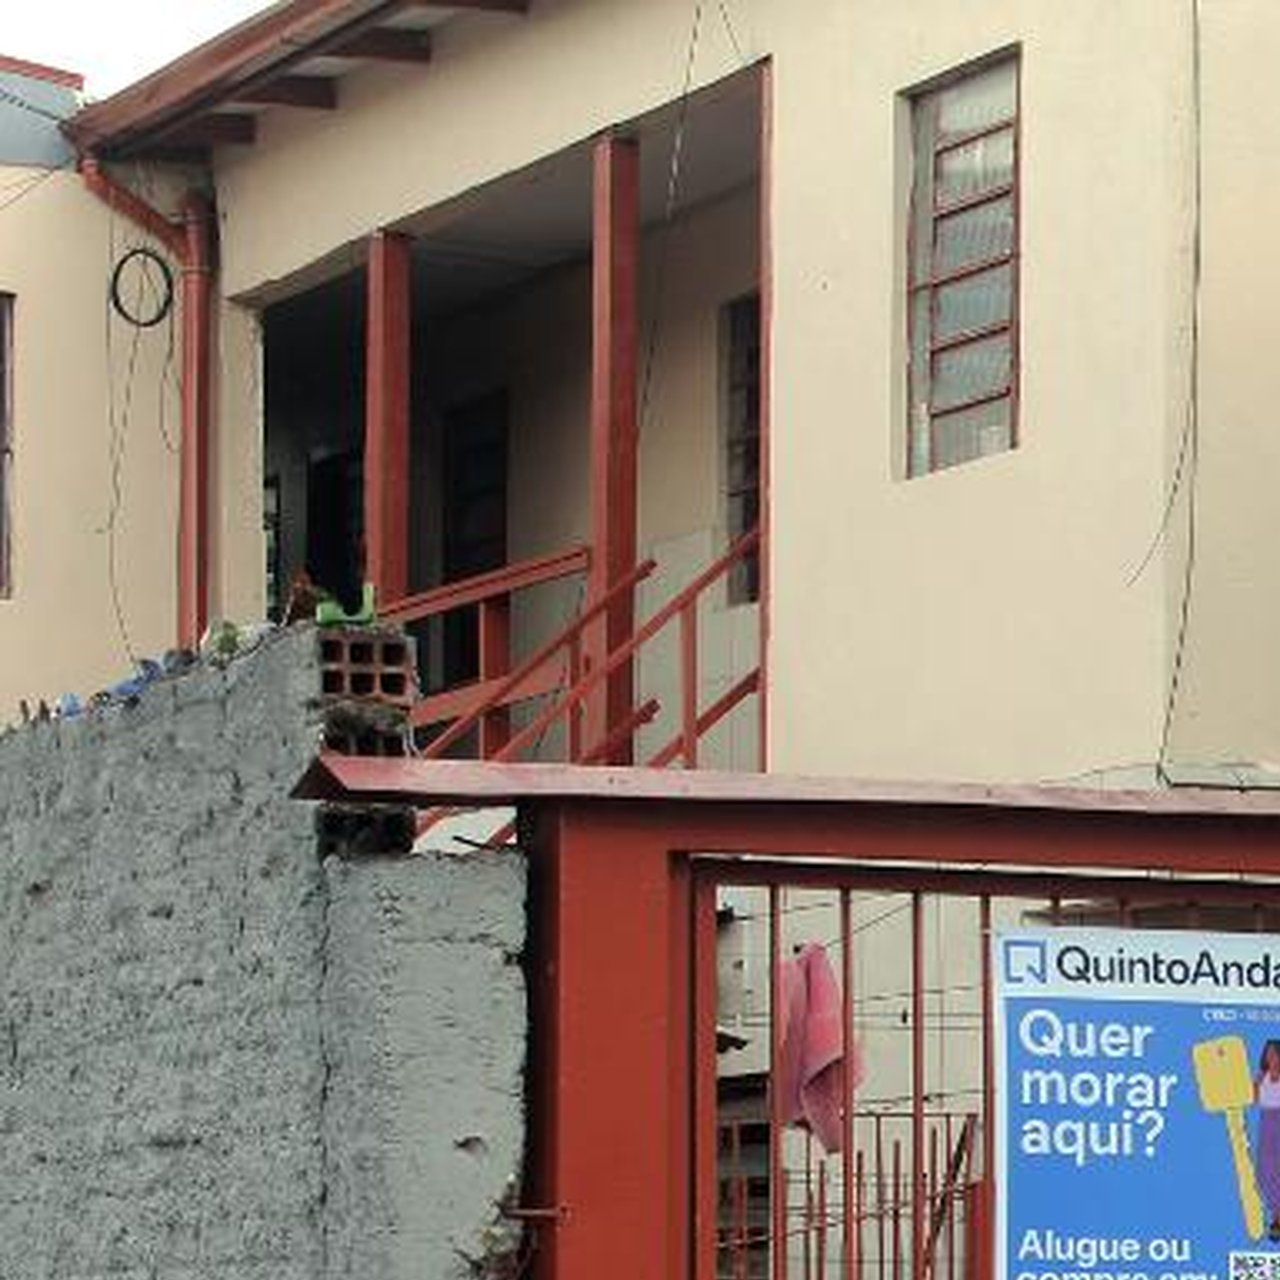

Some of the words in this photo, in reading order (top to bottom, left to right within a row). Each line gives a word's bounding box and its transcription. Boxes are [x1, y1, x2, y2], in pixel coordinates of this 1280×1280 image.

[1018, 1008, 1154, 1058] Quer
[1020, 1068, 1178, 1109] morar
[1019, 1110, 1165, 1166] aqui?
[1017, 1229, 1141, 1266] Alugue
[1148, 1236, 1191, 1262] ou
